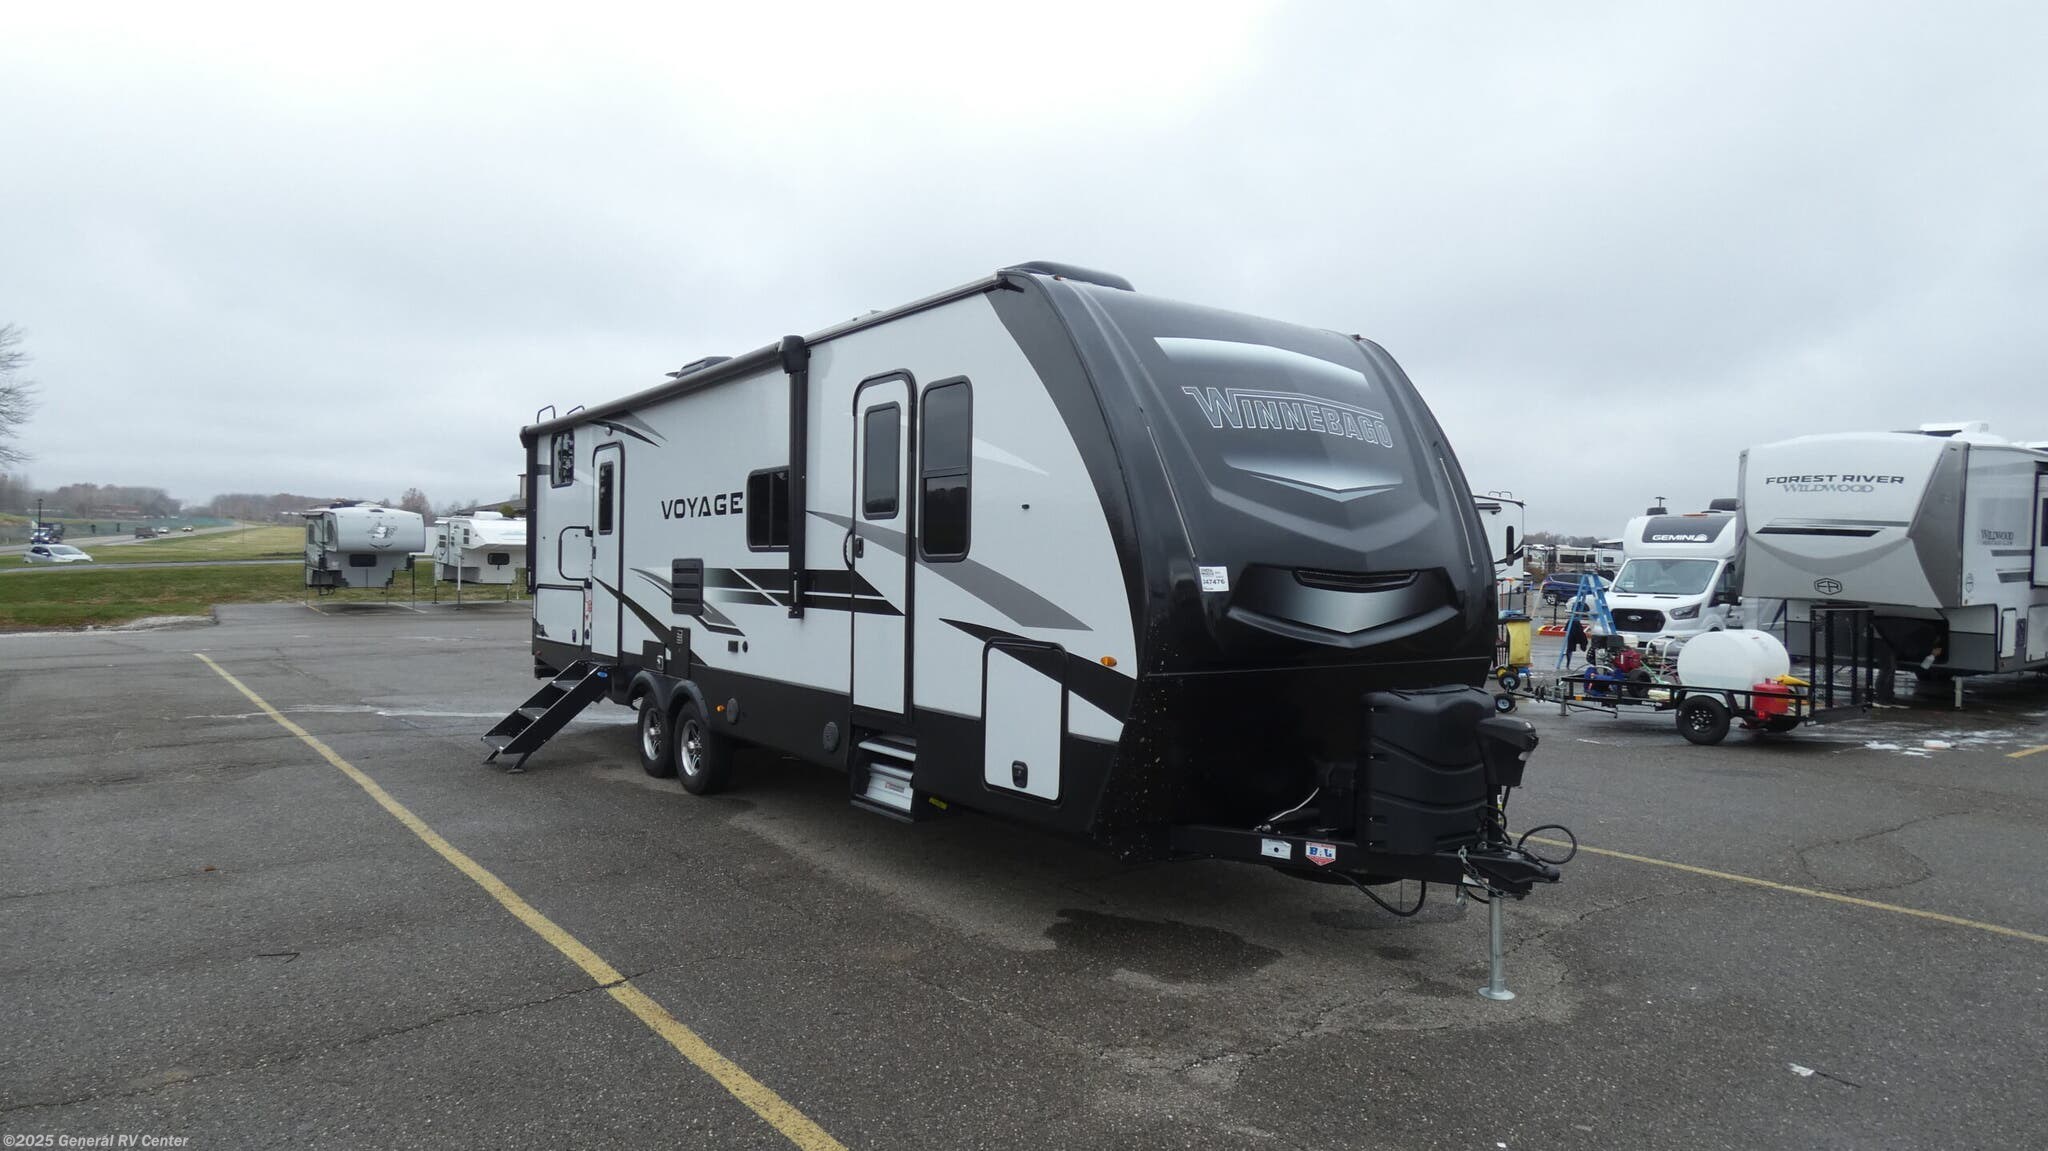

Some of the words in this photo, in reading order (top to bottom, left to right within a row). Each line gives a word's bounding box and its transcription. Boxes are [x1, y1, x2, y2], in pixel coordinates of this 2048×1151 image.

[1181, 386, 1393, 448] WINNEBAGO
[1765, 474, 1837, 485] FOREST
[1842, 474, 1905, 484] RIVER
[1782, 483, 1875, 493] WILDWOOD
[661, 491, 744, 520] VOYAGE
